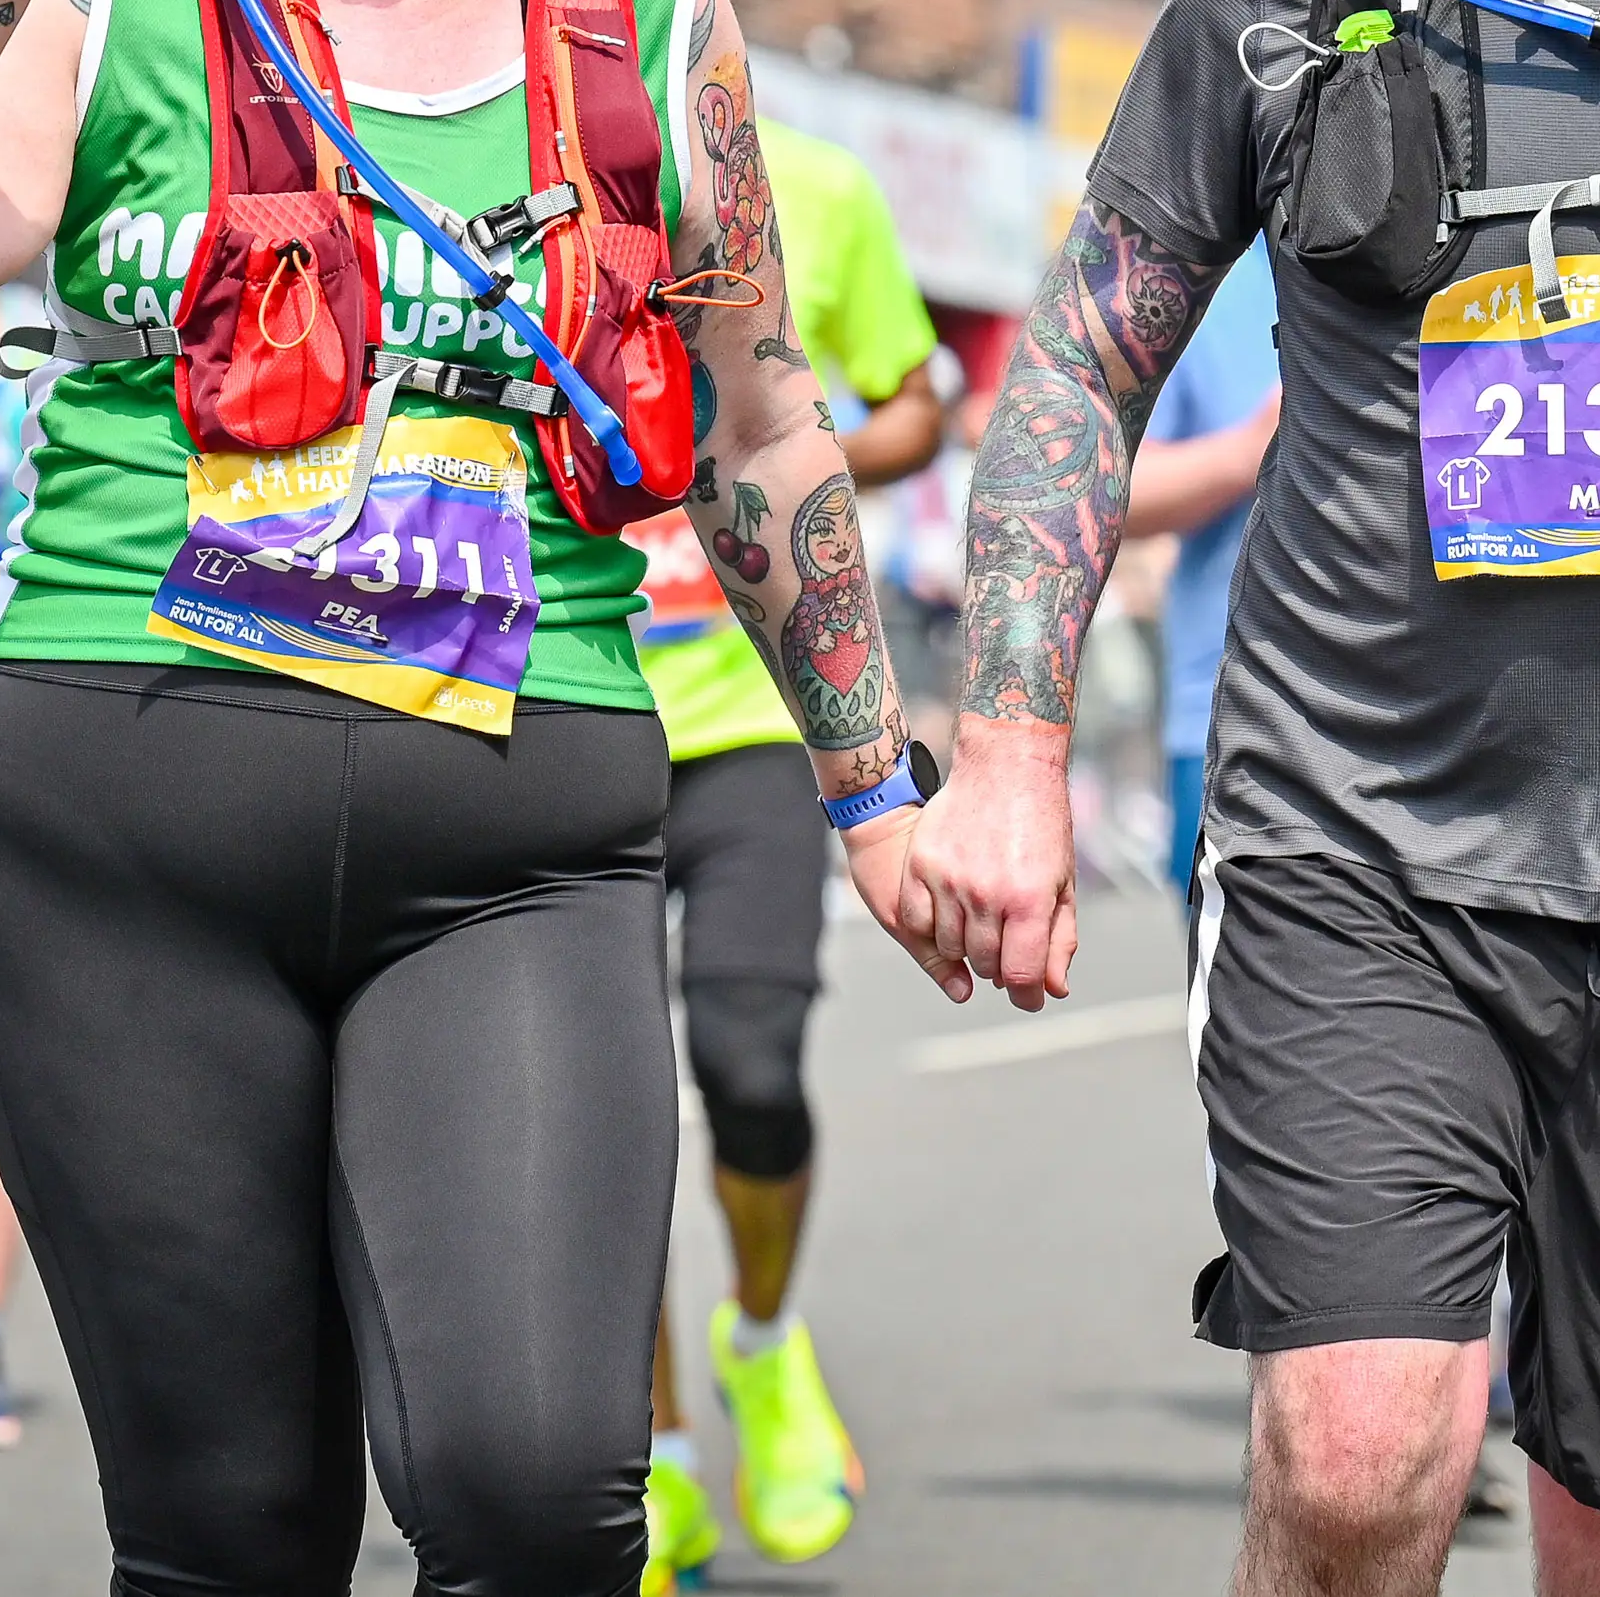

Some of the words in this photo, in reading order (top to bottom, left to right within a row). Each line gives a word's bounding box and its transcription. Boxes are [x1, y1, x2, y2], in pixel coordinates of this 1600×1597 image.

[250, 94, 301, 104] UTOBES
[298, 469, 355, 493] HAL
[1459, 474, 1471, 499] L
[1447, 535, 1465, 545] Jane
[1466, 532, 1514, 543] Tomlinson's
[1447, 542, 1478, 559] RUN
[1479, 542, 1508, 557] FOR
[1511, 544, 1539, 558] ALL
[208, 559, 221, 576] L
[174, 596, 195, 608] Jane
[197, 601, 245, 623] Tomlinson's
[320, 601, 381, 635] PEA
[169, 604, 204, 626] RUN
[204, 615, 236, 637] FOR
[236, 626, 265, 646] ALL
[453, 692, 497, 715] Leeds
